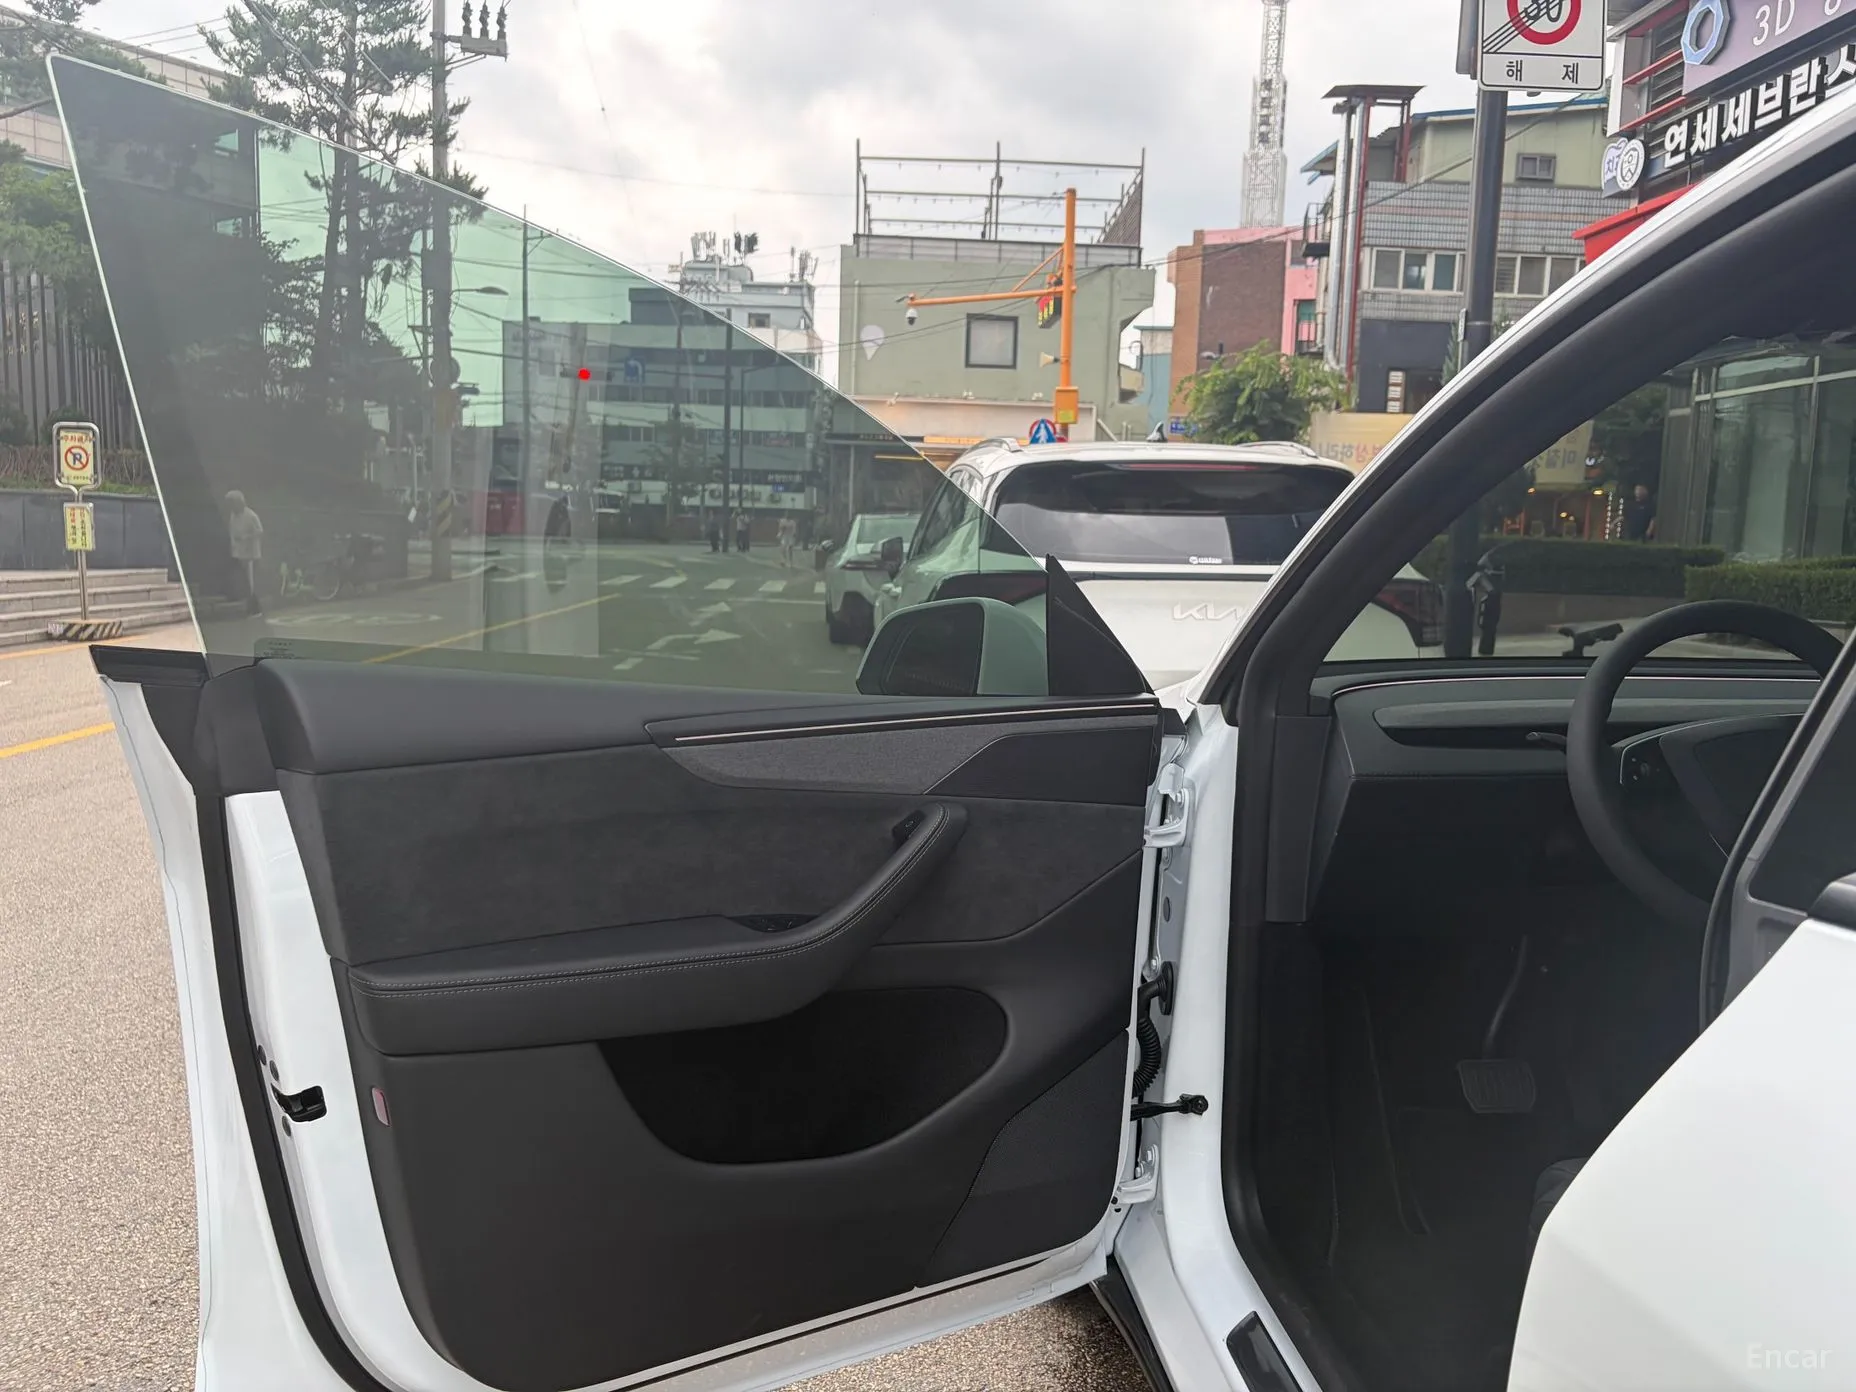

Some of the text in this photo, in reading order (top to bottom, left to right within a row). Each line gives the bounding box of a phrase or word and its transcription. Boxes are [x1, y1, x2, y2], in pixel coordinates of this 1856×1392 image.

[1752, 0, 1796, 46] 3D
[1506, 60, 1579, 84] 해 제
